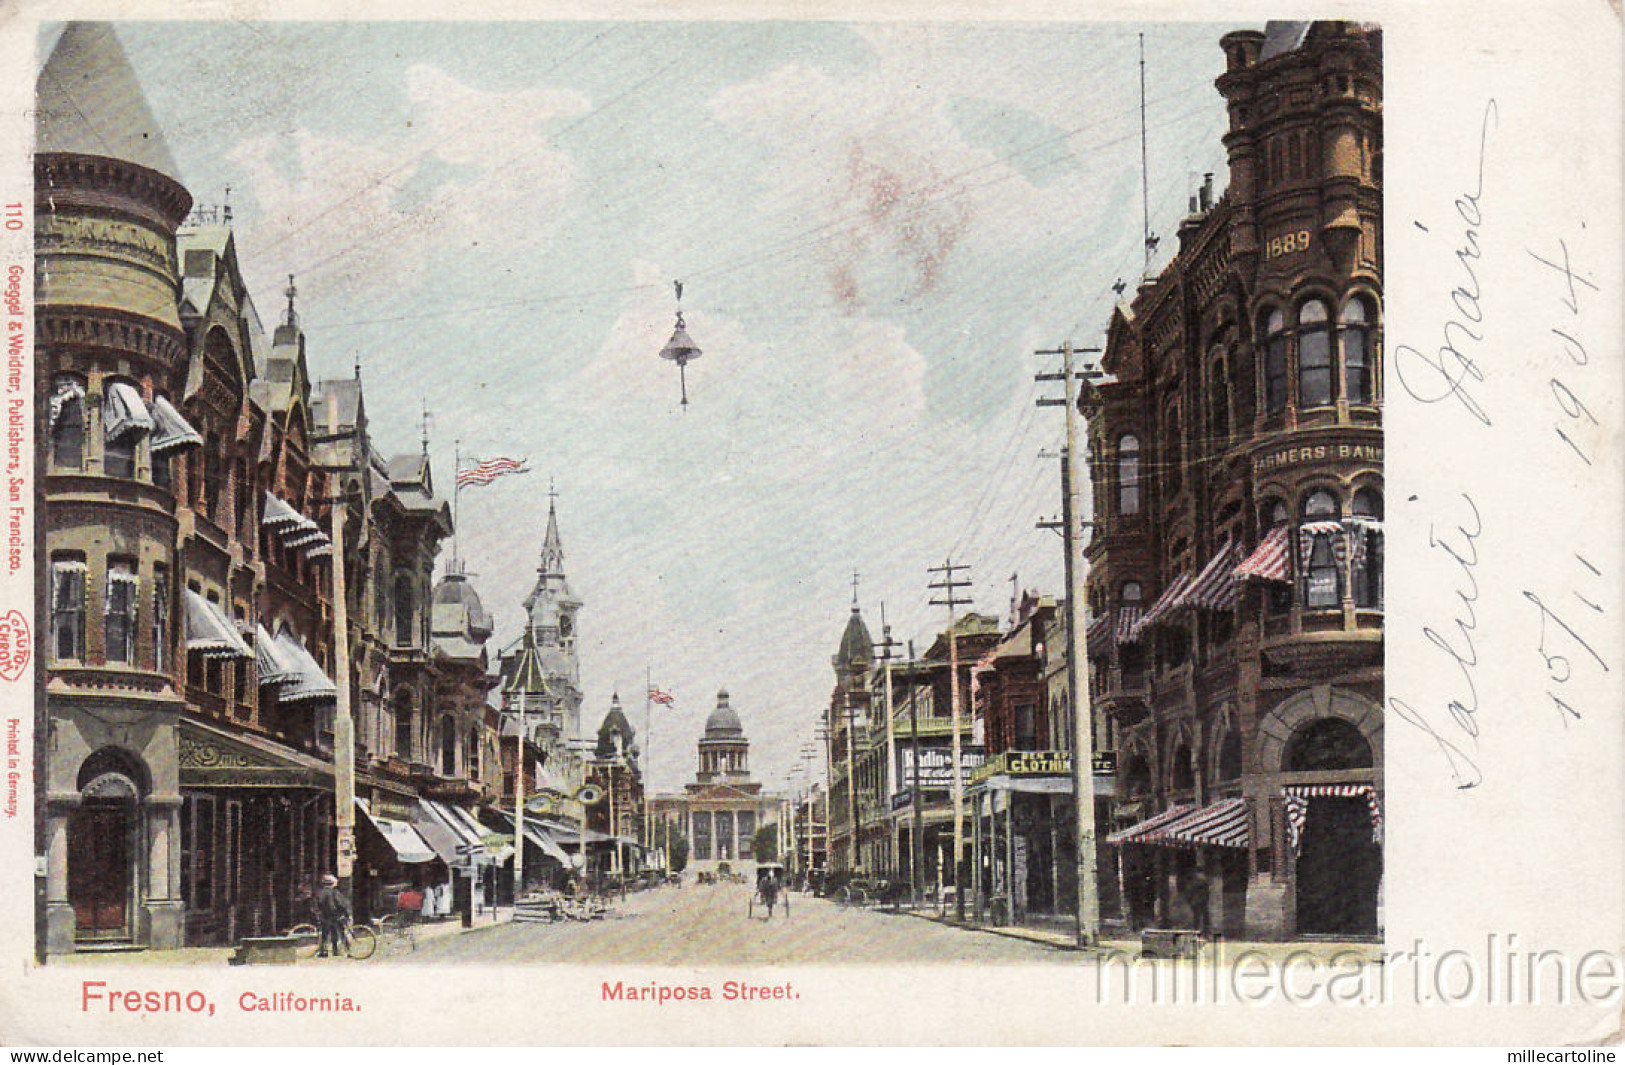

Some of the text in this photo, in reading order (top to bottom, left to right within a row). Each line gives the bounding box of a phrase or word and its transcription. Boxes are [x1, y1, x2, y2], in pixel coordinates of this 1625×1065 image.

[4, 203, 24, 231] 110
[1266, 230, 1310, 258] 1889
[4, 264, 25, 577] Goeggel & Weidner, Publishers, San Francisco.
[4, 718, 21, 818] Printed in Germany.
[82, 981, 362, 1017] Fresno, California.
[601, 980, 800, 1006] Mariposa Street.
